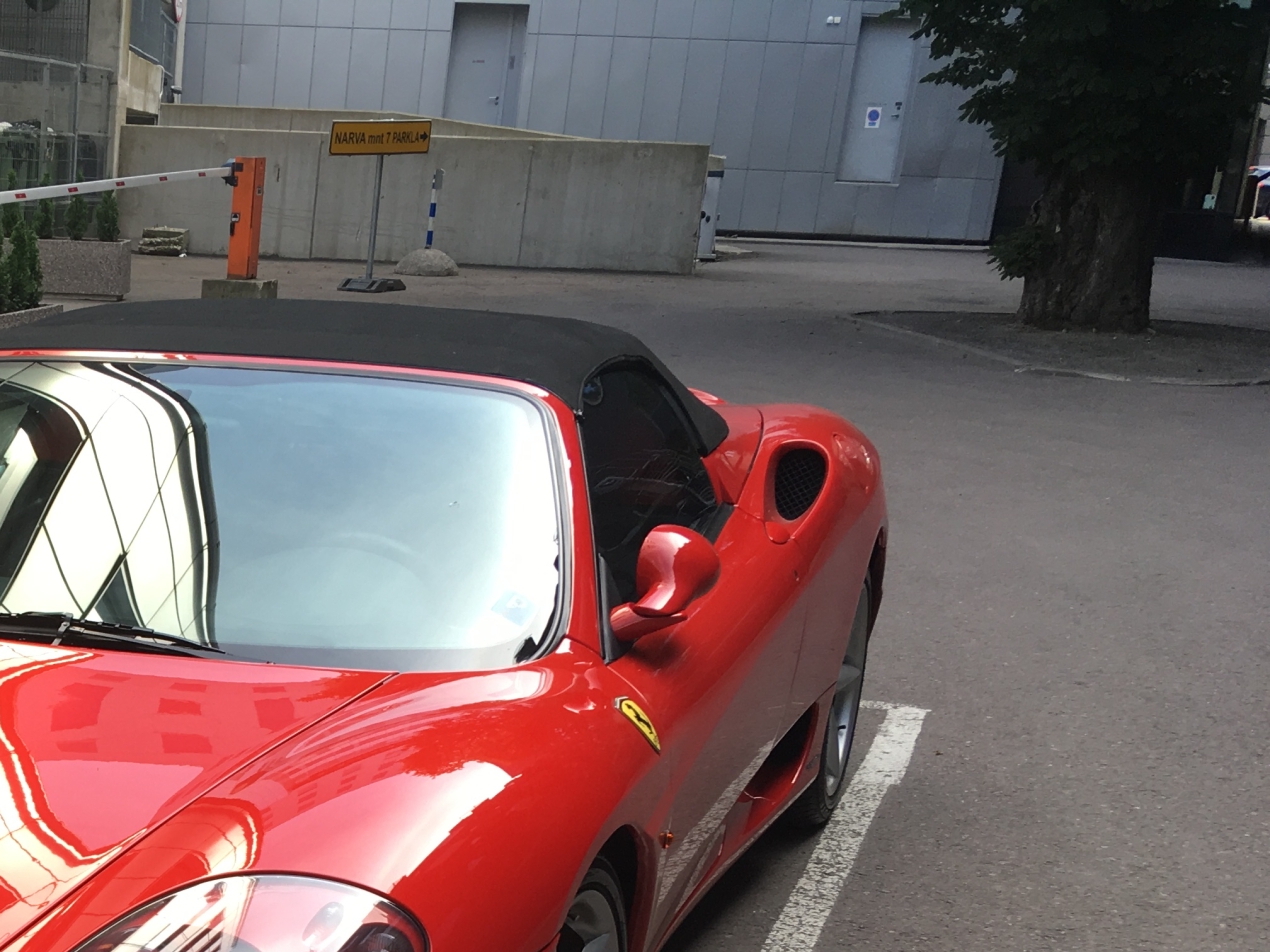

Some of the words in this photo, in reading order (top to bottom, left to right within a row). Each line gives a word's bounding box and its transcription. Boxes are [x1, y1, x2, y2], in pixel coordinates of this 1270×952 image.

[335, 132, 366, 144] NARVA
[367, 133, 384, 144] mnt
[386, 132, 392, 143] 7
[392, 131, 420, 143] PARKLA
